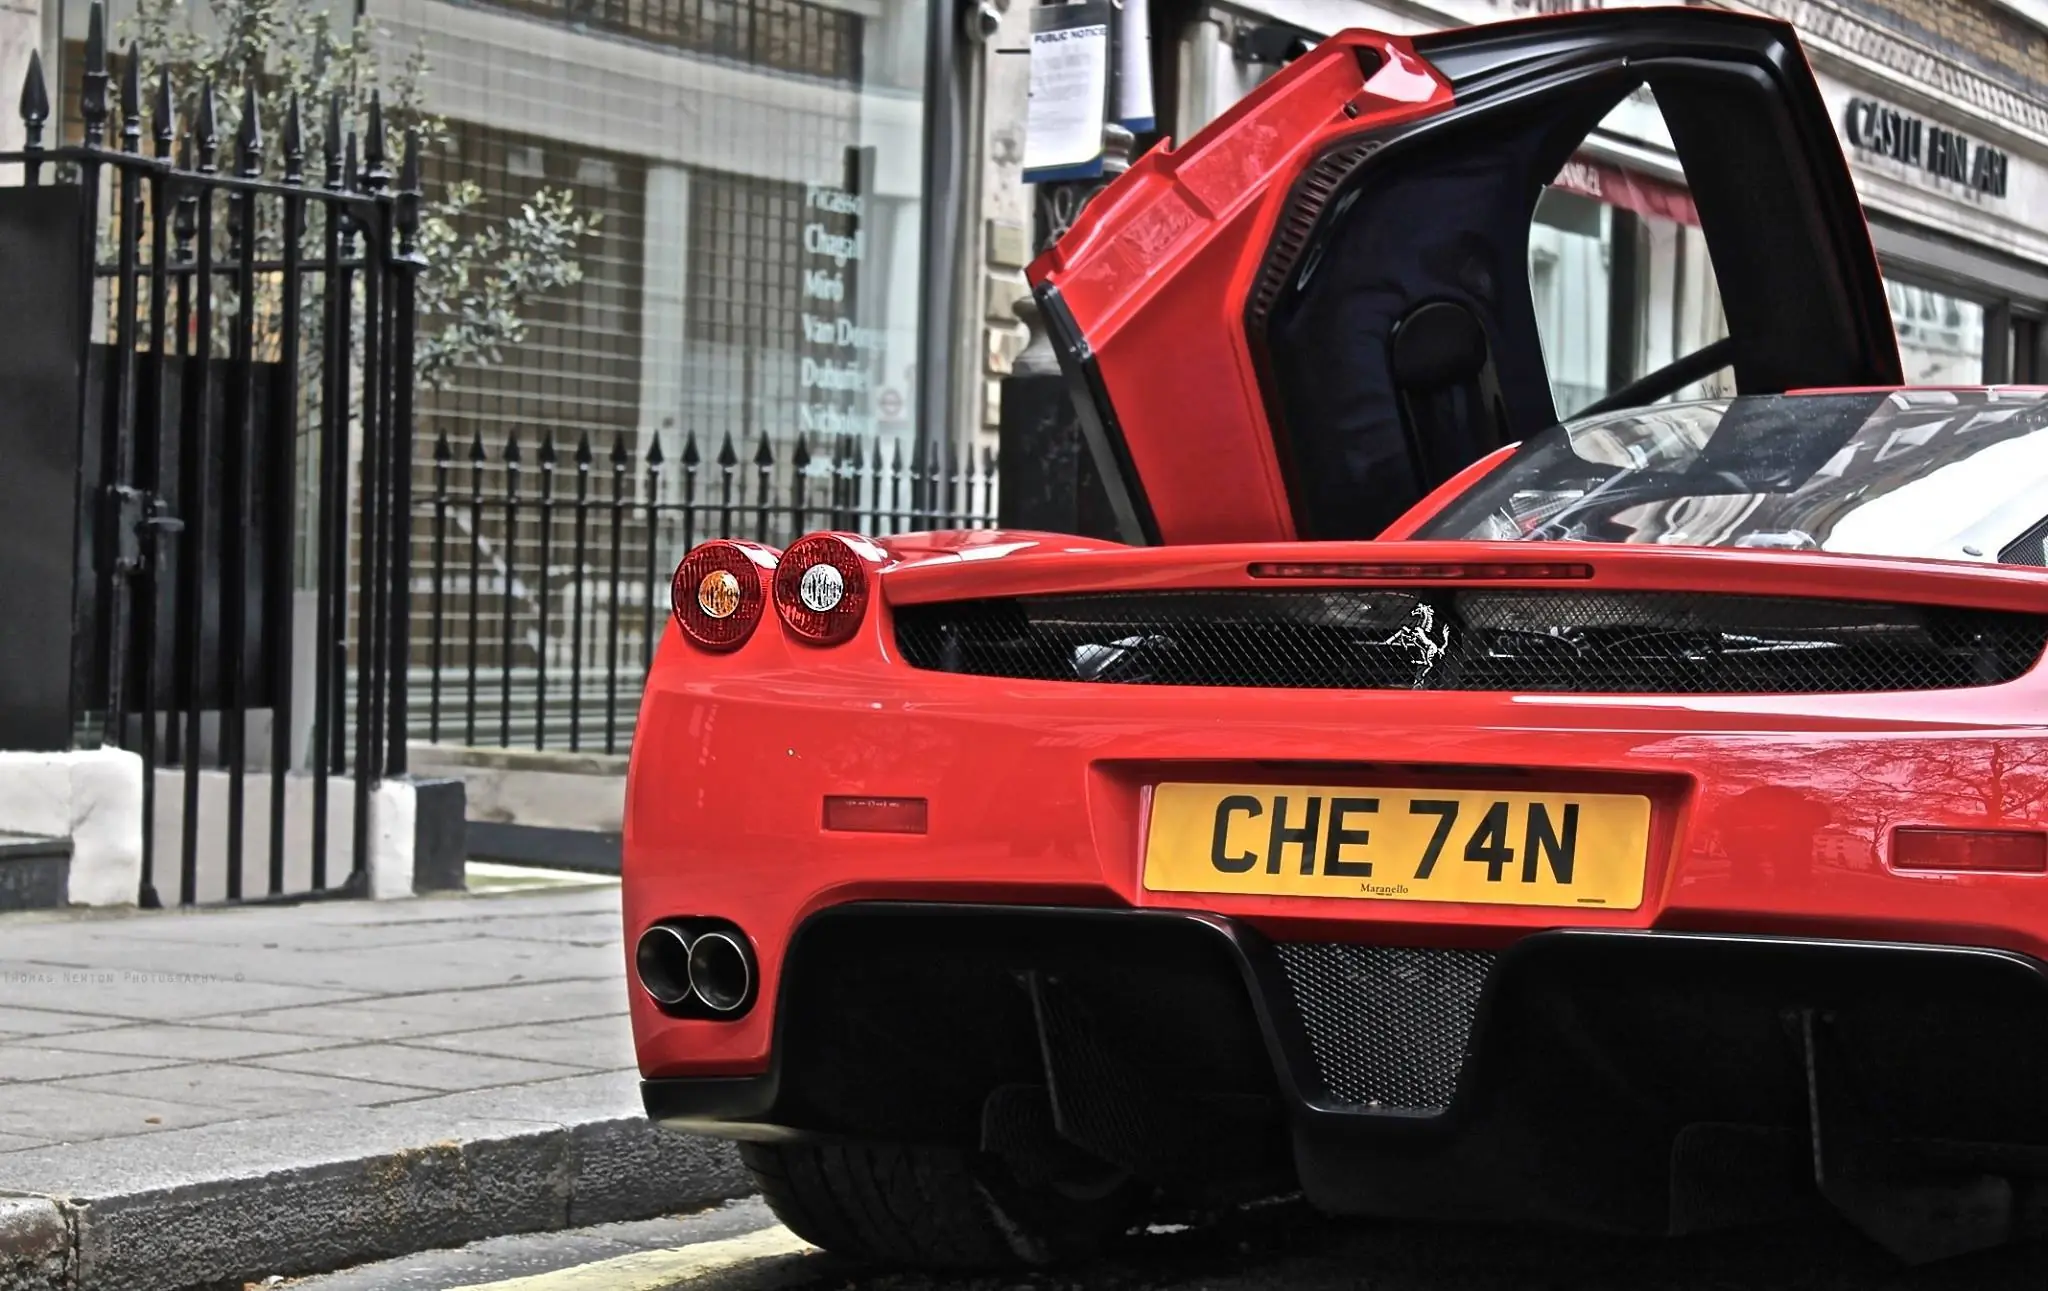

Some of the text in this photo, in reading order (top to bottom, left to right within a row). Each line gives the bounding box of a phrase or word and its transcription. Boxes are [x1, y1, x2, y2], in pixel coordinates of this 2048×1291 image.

[1034, 26, 1107, 43] PUBLIC NOTICE
[1210, 794, 1580, 885] CHE 74N
[1360, 883, 1409, 894] Maranello
